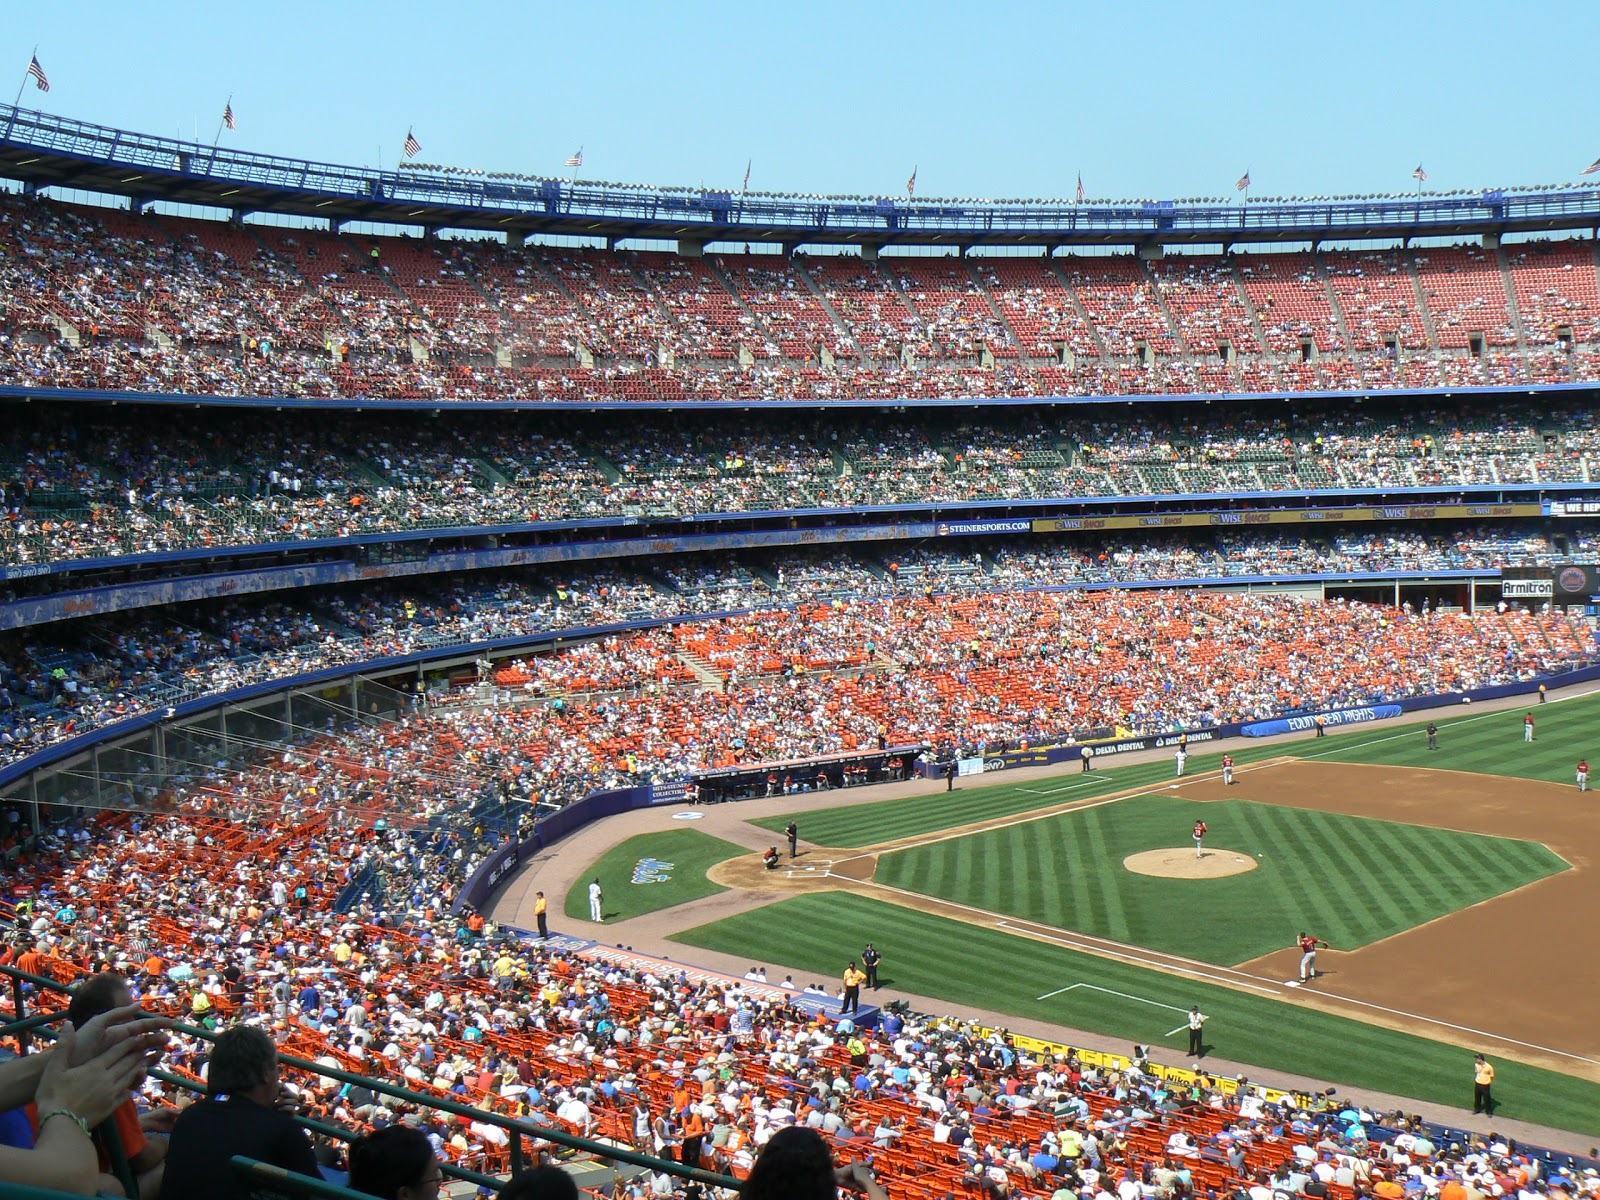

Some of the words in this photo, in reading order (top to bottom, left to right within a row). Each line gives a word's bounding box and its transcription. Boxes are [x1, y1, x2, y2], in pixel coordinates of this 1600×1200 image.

[1384, 508, 1406, 518] WISE
[1566, 503, 1582, 512] WE
[1220, 513, 1242, 523] WISE
[949, 521, 1030, 533] STEINERSPORTS.COM
[1503, 583, 1552, 593] Armitron
[1342, 707, 1376, 723] RIGHTS
[1165, 737, 1182, 745] DELT
[1187, 731, 1213, 742] DENTAL
[1095, 744, 1117, 756] DELTA
[1118, 741, 1145, 752] DENTAL
[585, 948, 630, 962] YOUR
[1166, 1073, 1190, 1086] Niko
